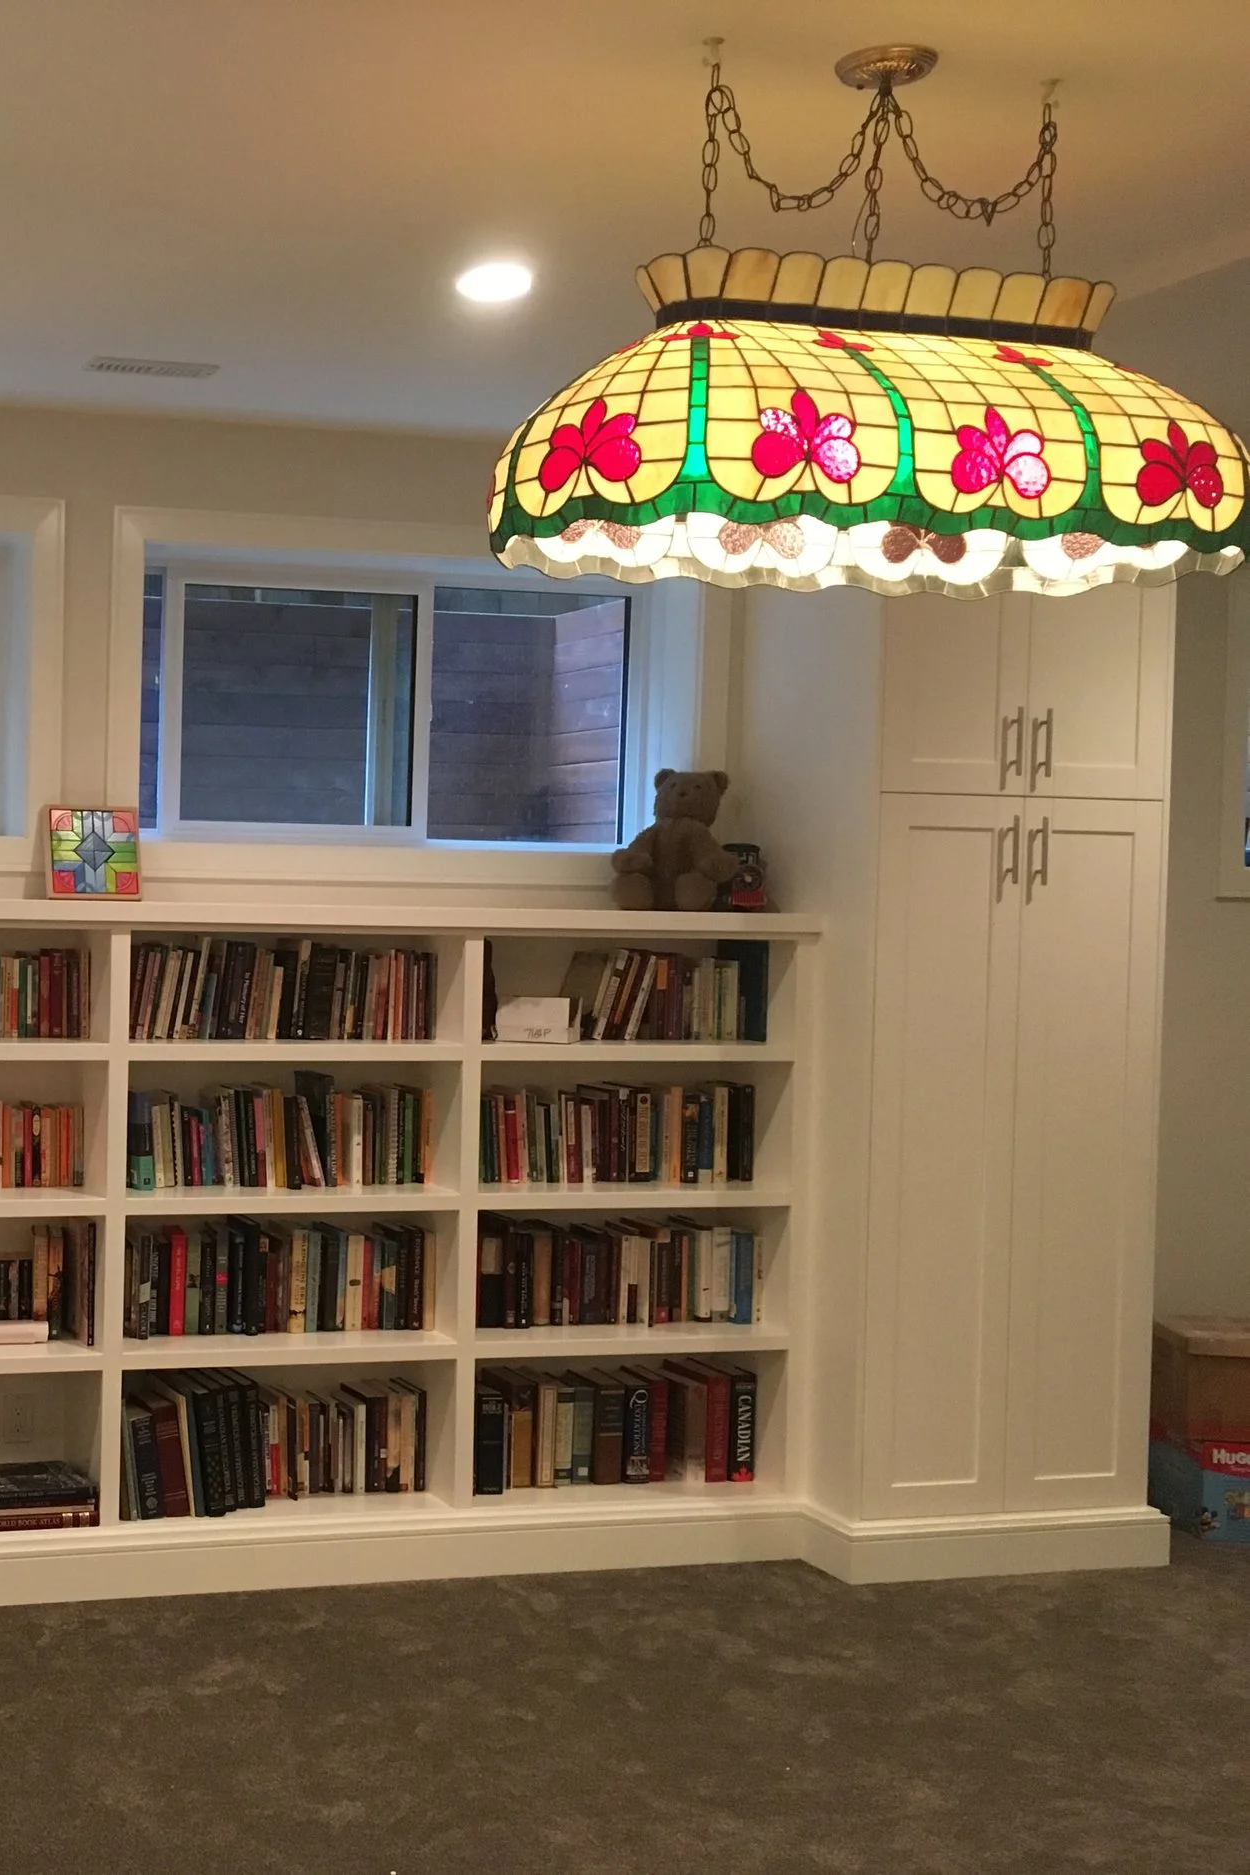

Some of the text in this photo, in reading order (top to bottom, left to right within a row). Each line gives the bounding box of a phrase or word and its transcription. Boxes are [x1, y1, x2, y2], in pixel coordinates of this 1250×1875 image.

[737, 1395, 752, 1462] CANADIAN
[17, 1519, 37, 1527] BOOK
[38, 1517, 61, 1525] ATLAS
